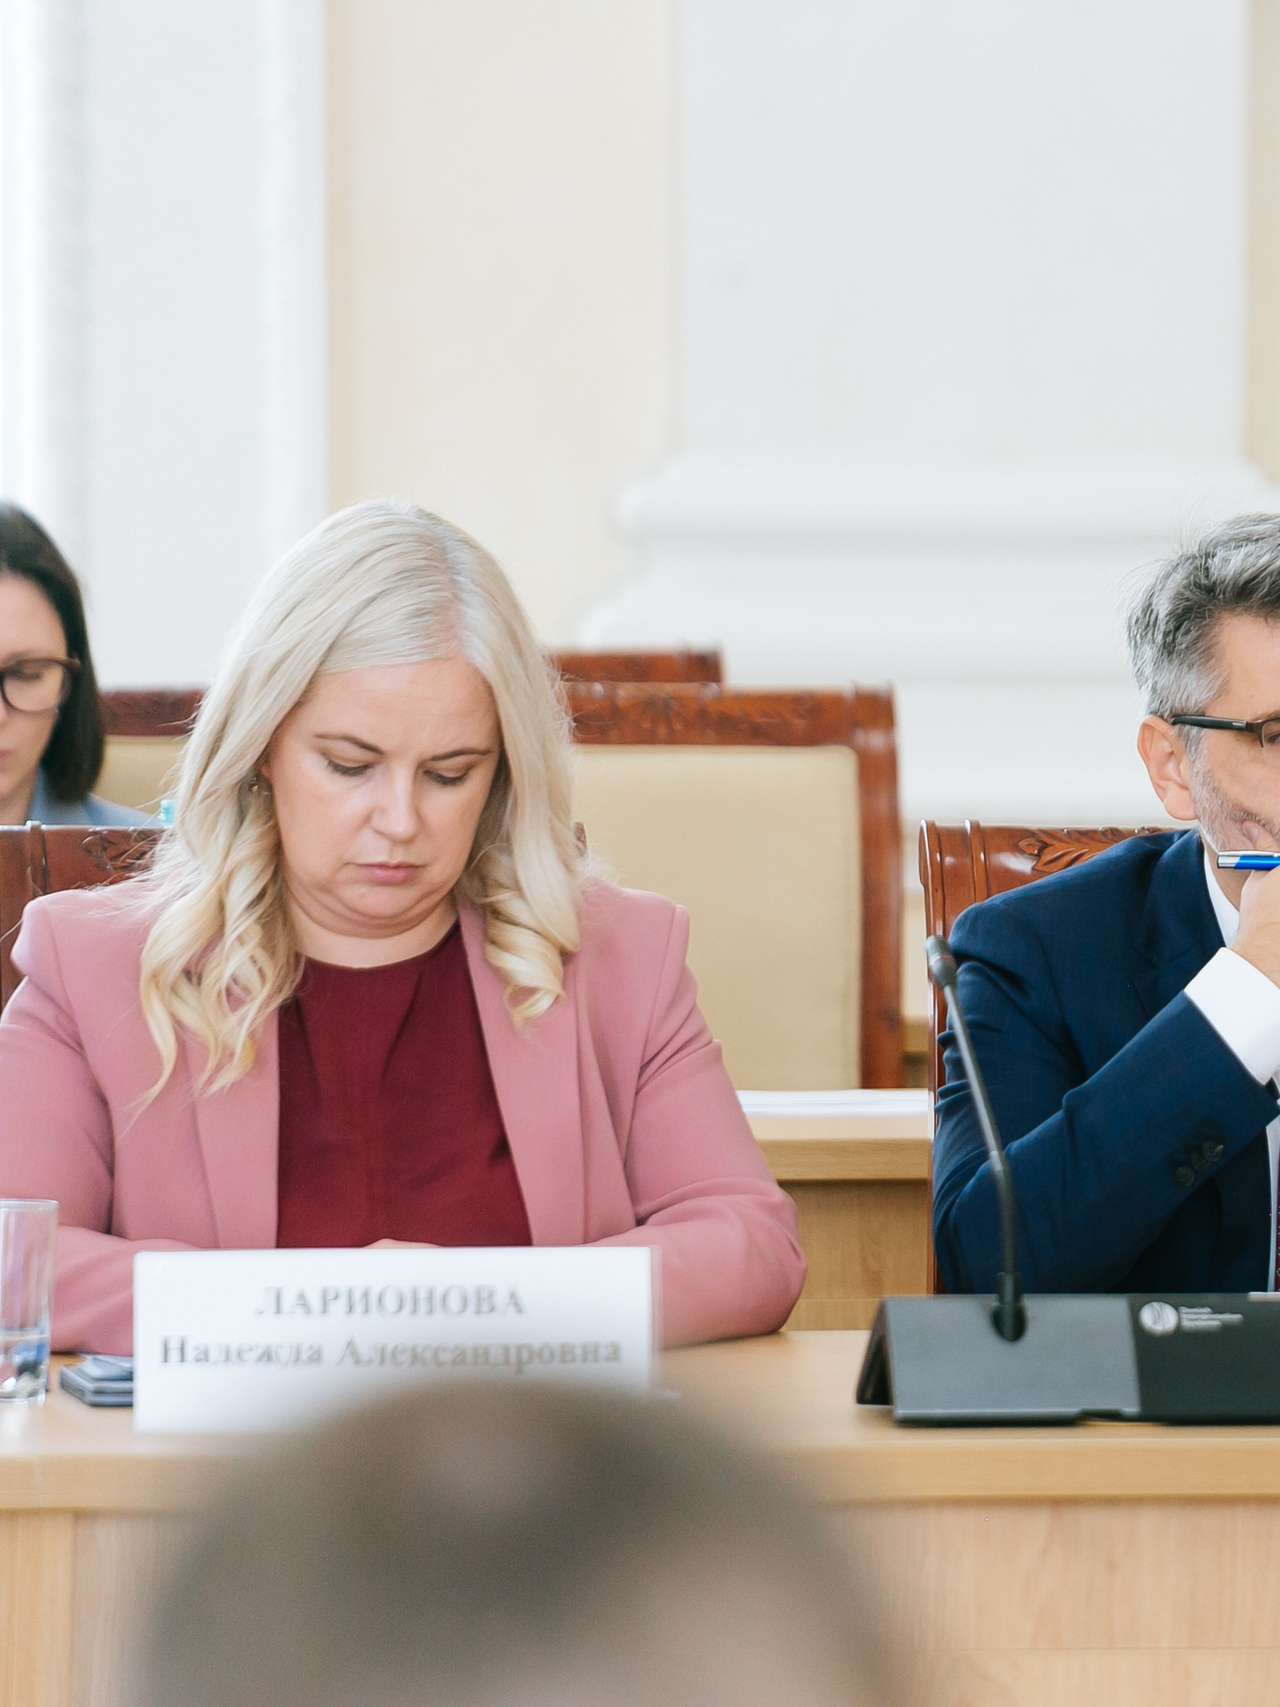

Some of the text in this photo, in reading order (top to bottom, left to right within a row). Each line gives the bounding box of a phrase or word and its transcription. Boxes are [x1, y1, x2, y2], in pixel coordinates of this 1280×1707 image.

[257, 1285, 525, 1318] ЛАРИОНОВА
[160, 1335, 623, 1375] Надежда Александровна
